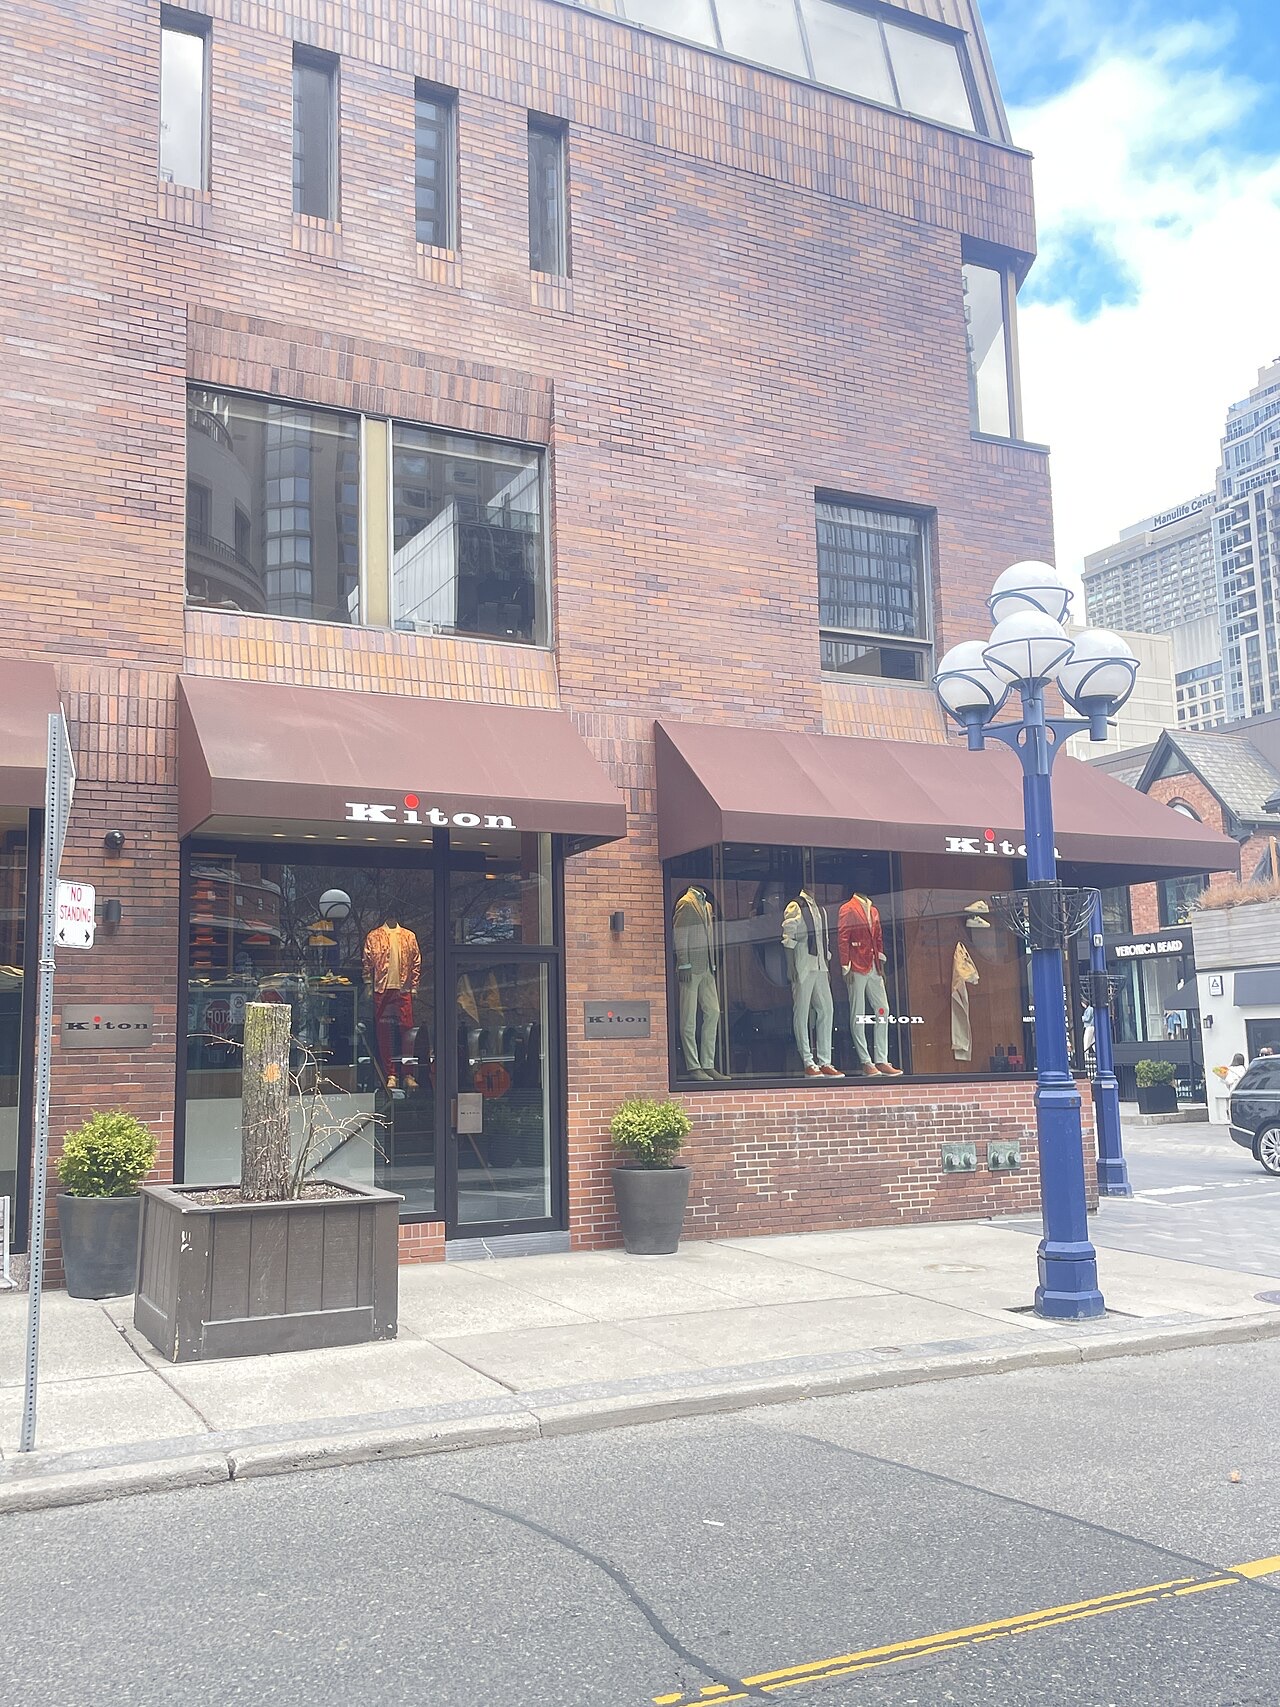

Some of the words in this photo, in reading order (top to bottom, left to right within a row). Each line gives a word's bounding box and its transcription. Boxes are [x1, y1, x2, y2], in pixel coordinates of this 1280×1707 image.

[1154, 505, 1190, 527] Manulife
[345, 794, 517, 830] Kiton
[70, 886, 82, 902] NO
[59, 905, 91, 923] STANDING
[1115, 942, 1156, 957] VERONICA
[1157, 940, 1183, 953] BEARD
[65, 1015, 148, 1031] Kiton
[587, 1010, 648, 1023] Kiton
[854, 1007, 925, 1024] Kiton
